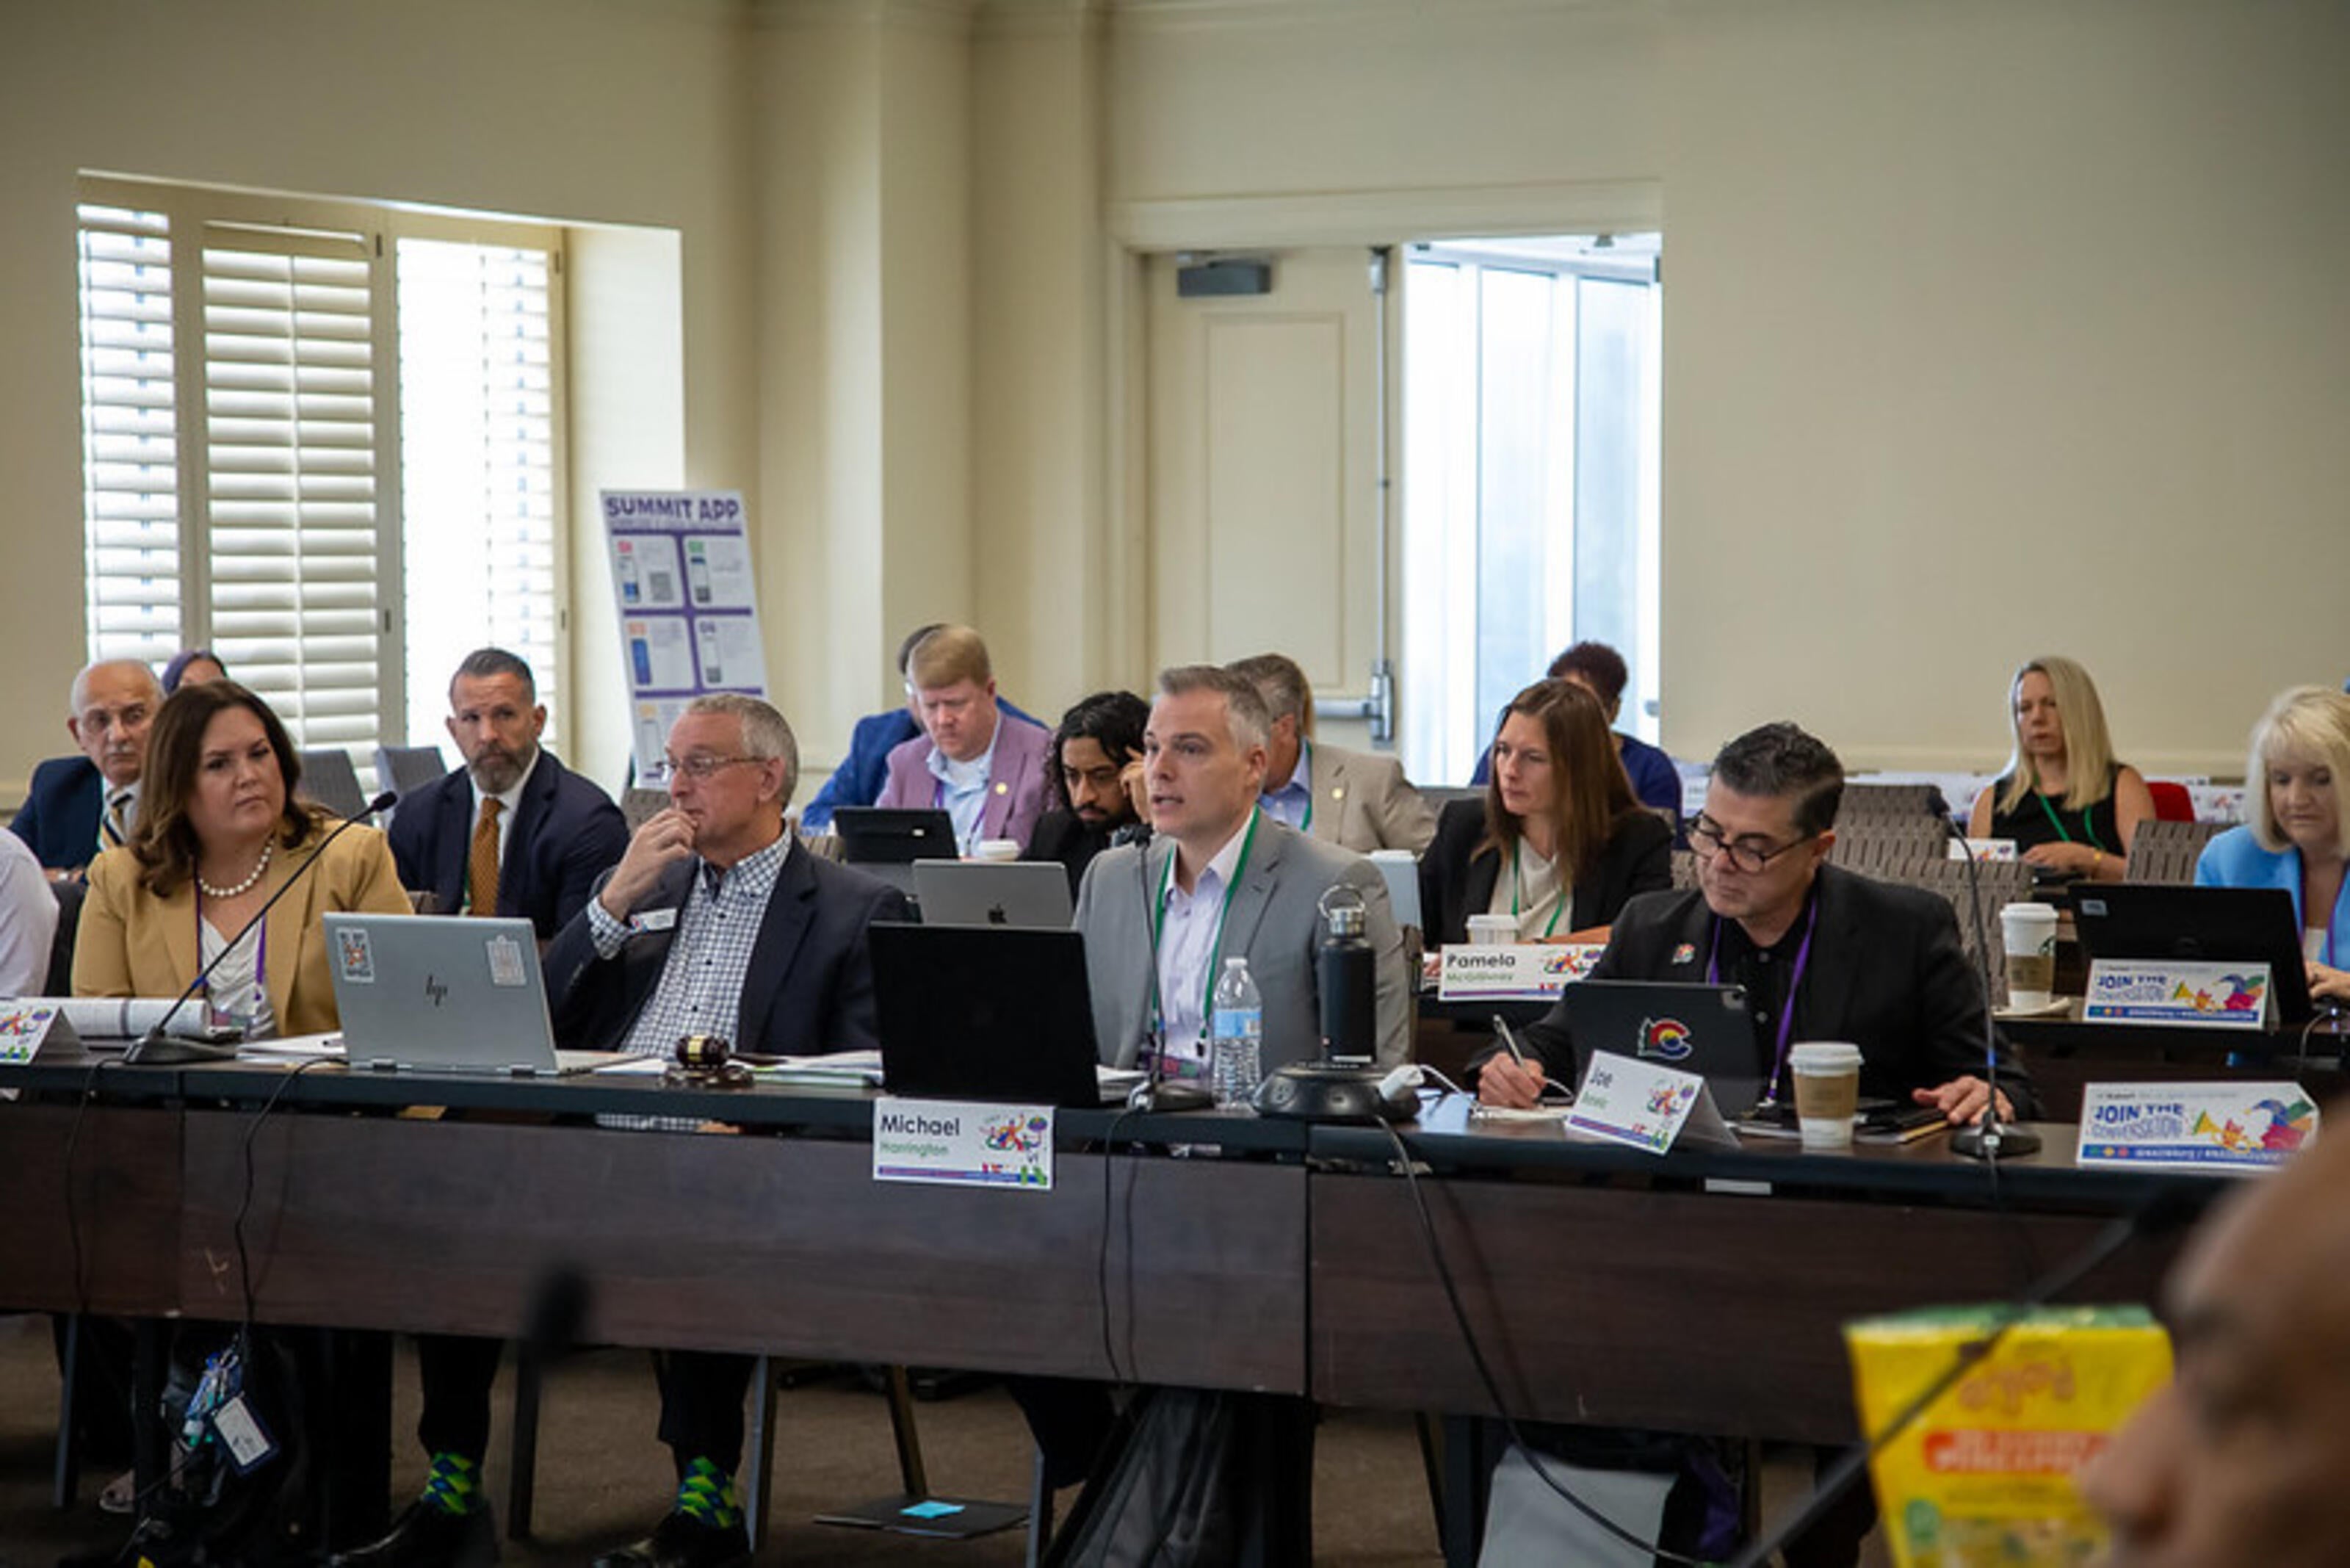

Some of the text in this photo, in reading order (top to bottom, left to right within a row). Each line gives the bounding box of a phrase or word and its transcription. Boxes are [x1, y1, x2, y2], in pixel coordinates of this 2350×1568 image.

[607, 497, 739, 521] SUMMIT APP
[1446, 953, 1516, 969] Pamela
[2097, 974, 2167, 989] JOIN THE
[1588, 1067, 1613, 1089] Joe
[2094, 1103, 2183, 1124] JOIN THE
[881, 1115, 961, 1136] Michael
